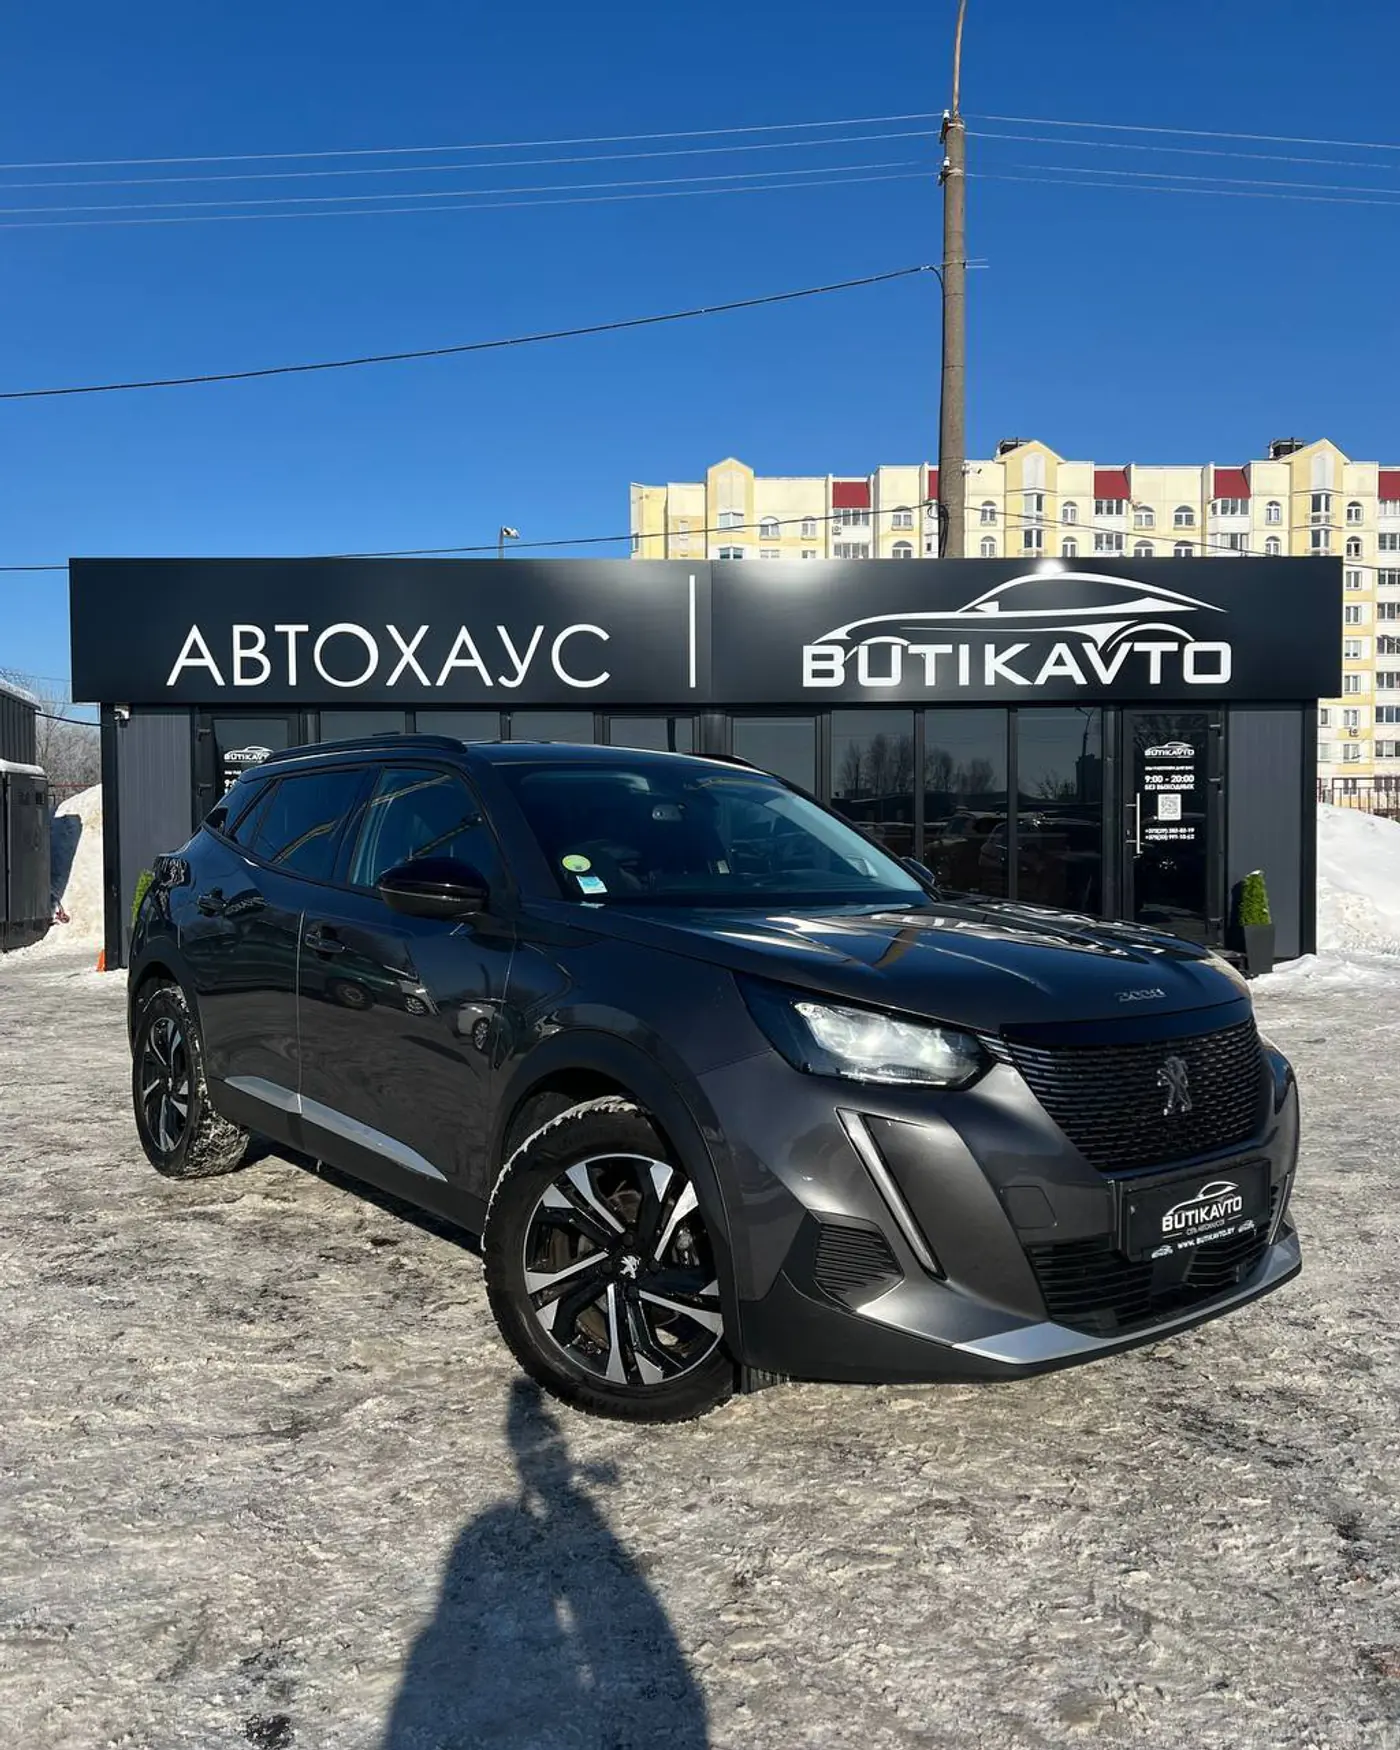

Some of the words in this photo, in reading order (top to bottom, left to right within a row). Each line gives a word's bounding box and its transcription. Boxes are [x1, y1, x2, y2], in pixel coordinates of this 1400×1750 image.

[166, 623, 611, 688] АВТОХАУС
[802, 641, 1232, 687] BUTIKAVTO
[1144, 775, 1164, 783] 9:00
[1170, 775, 1195, 783] 20:00
[1162, 1196, 1242, 1231] BUTIKAVTO
